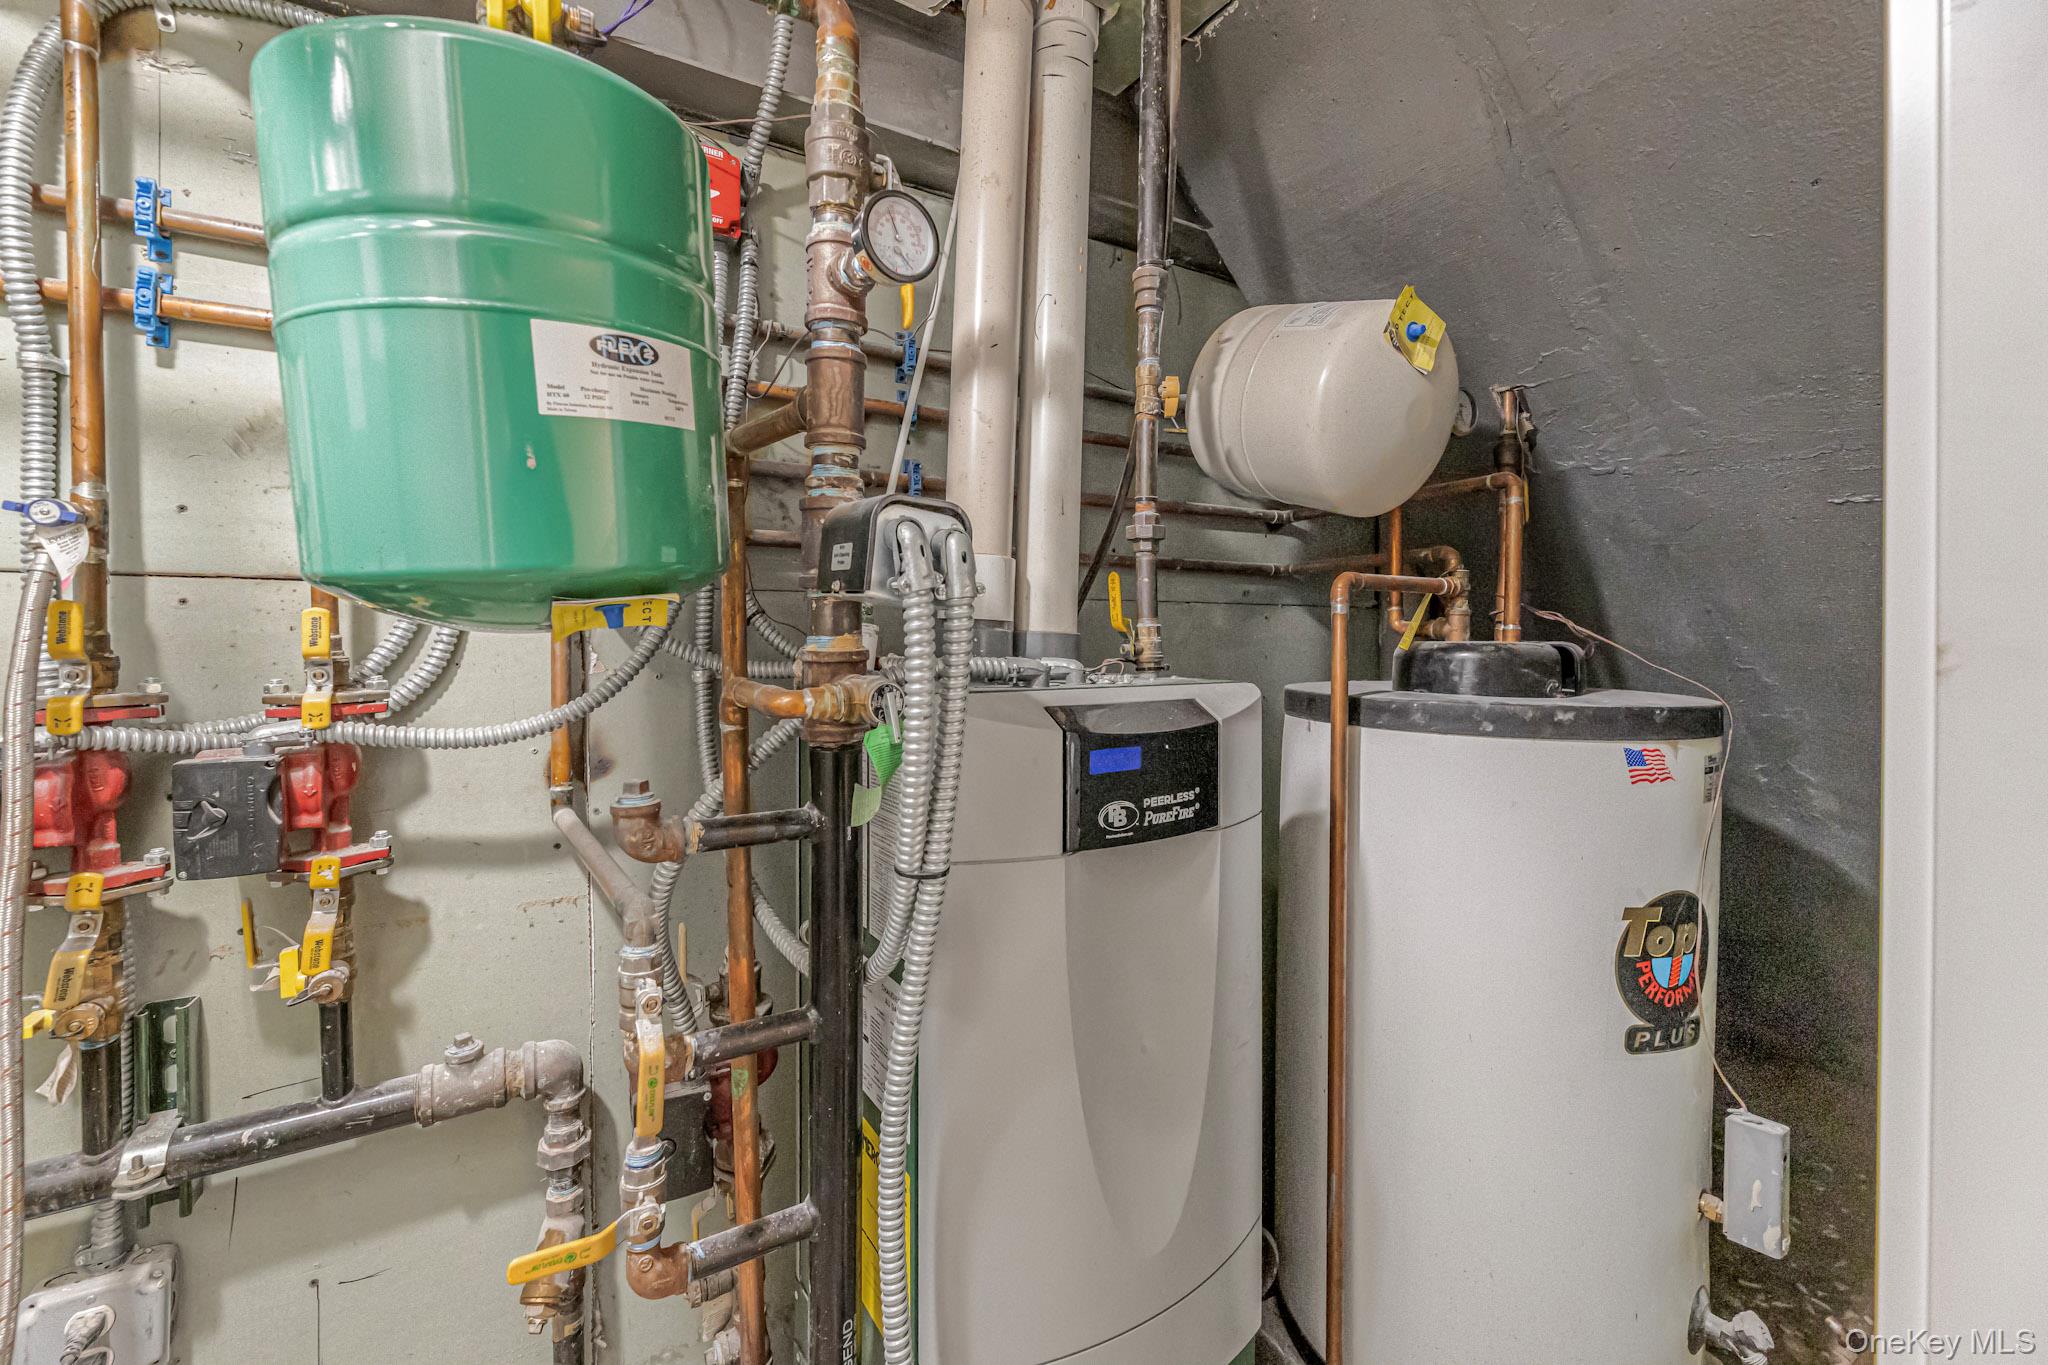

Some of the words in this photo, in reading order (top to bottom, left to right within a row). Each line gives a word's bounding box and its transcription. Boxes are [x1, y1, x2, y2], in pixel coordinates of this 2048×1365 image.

[701, 145, 724, 158] RNER
[55, 610, 67, 645] Webstone
[309, 616, 319, 648] Webstone
[1621, 906, 1698, 957] Top
[313, 938, 324, 969] Webstone
[57, 967, 76, 1002] Webstone
[1634, 1022, 1696, 1049] PLUS
